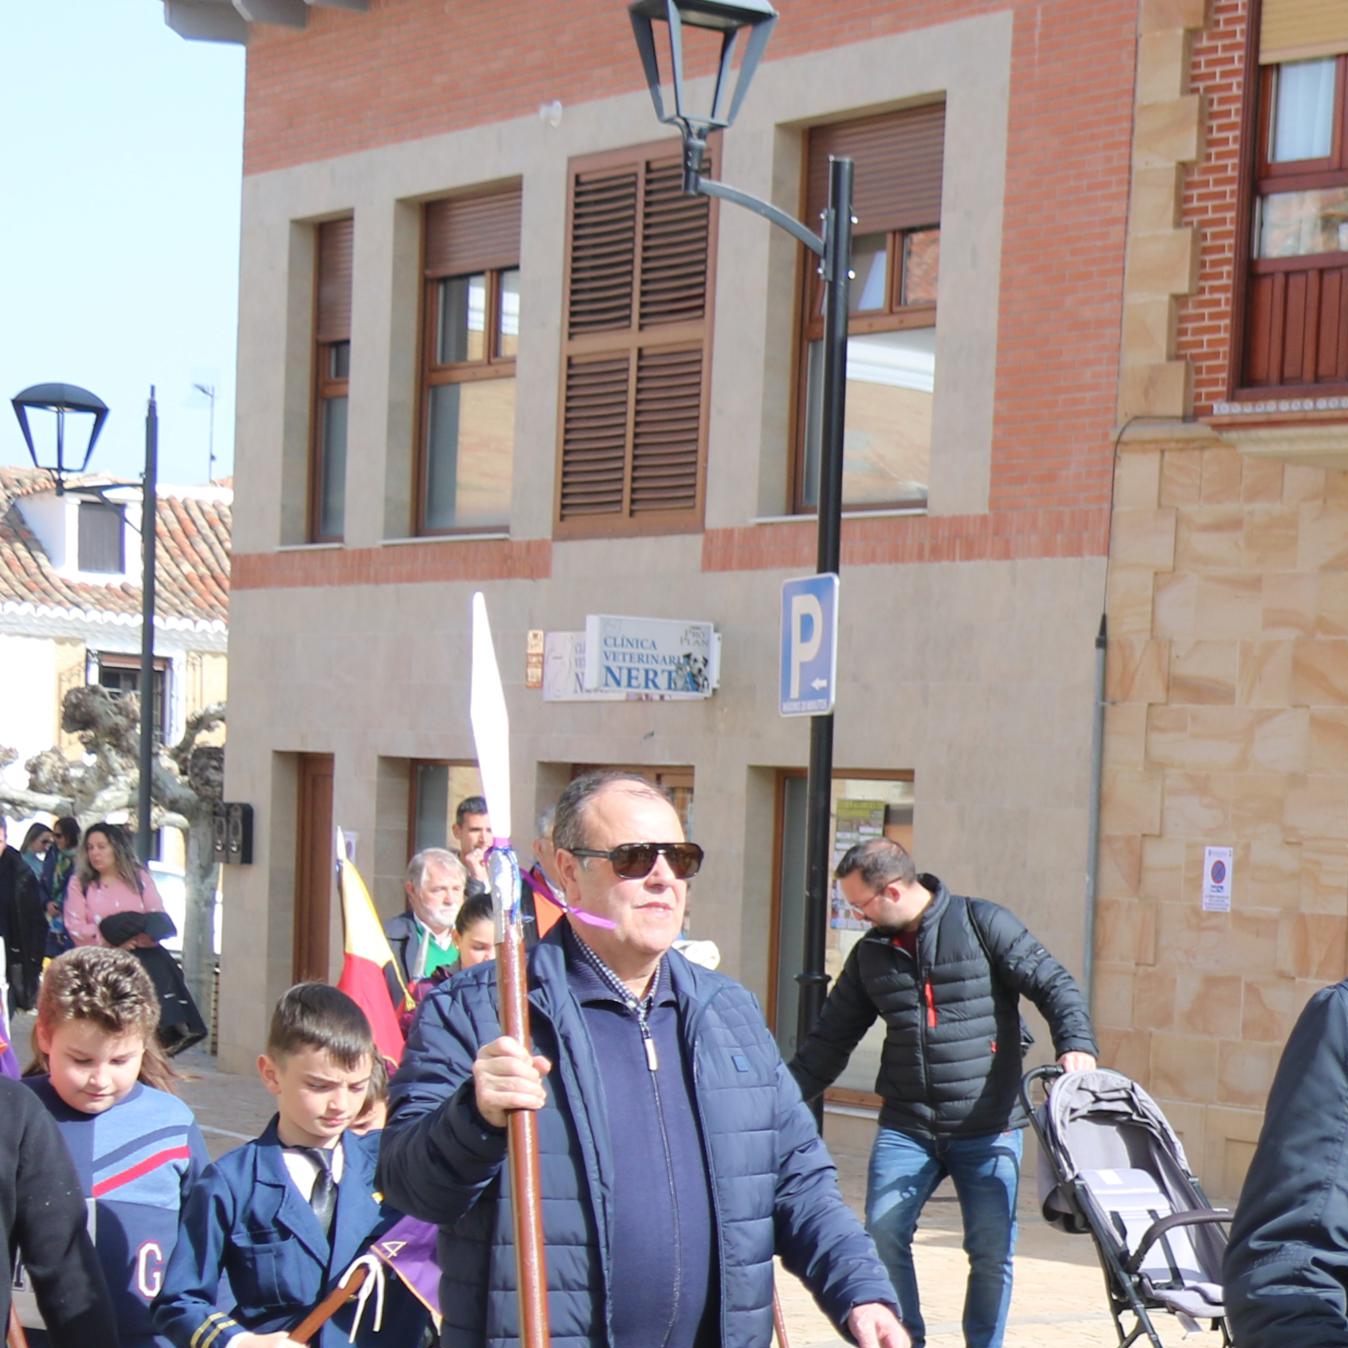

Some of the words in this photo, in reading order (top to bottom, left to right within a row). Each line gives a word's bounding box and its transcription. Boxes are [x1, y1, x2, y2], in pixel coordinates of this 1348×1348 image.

[603, 635, 657, 650] CLÍNICA
[790, 593, 823, 699] P
[603, 665, 699, 691] NERTA
[138, 1240, 163, 1299] G
